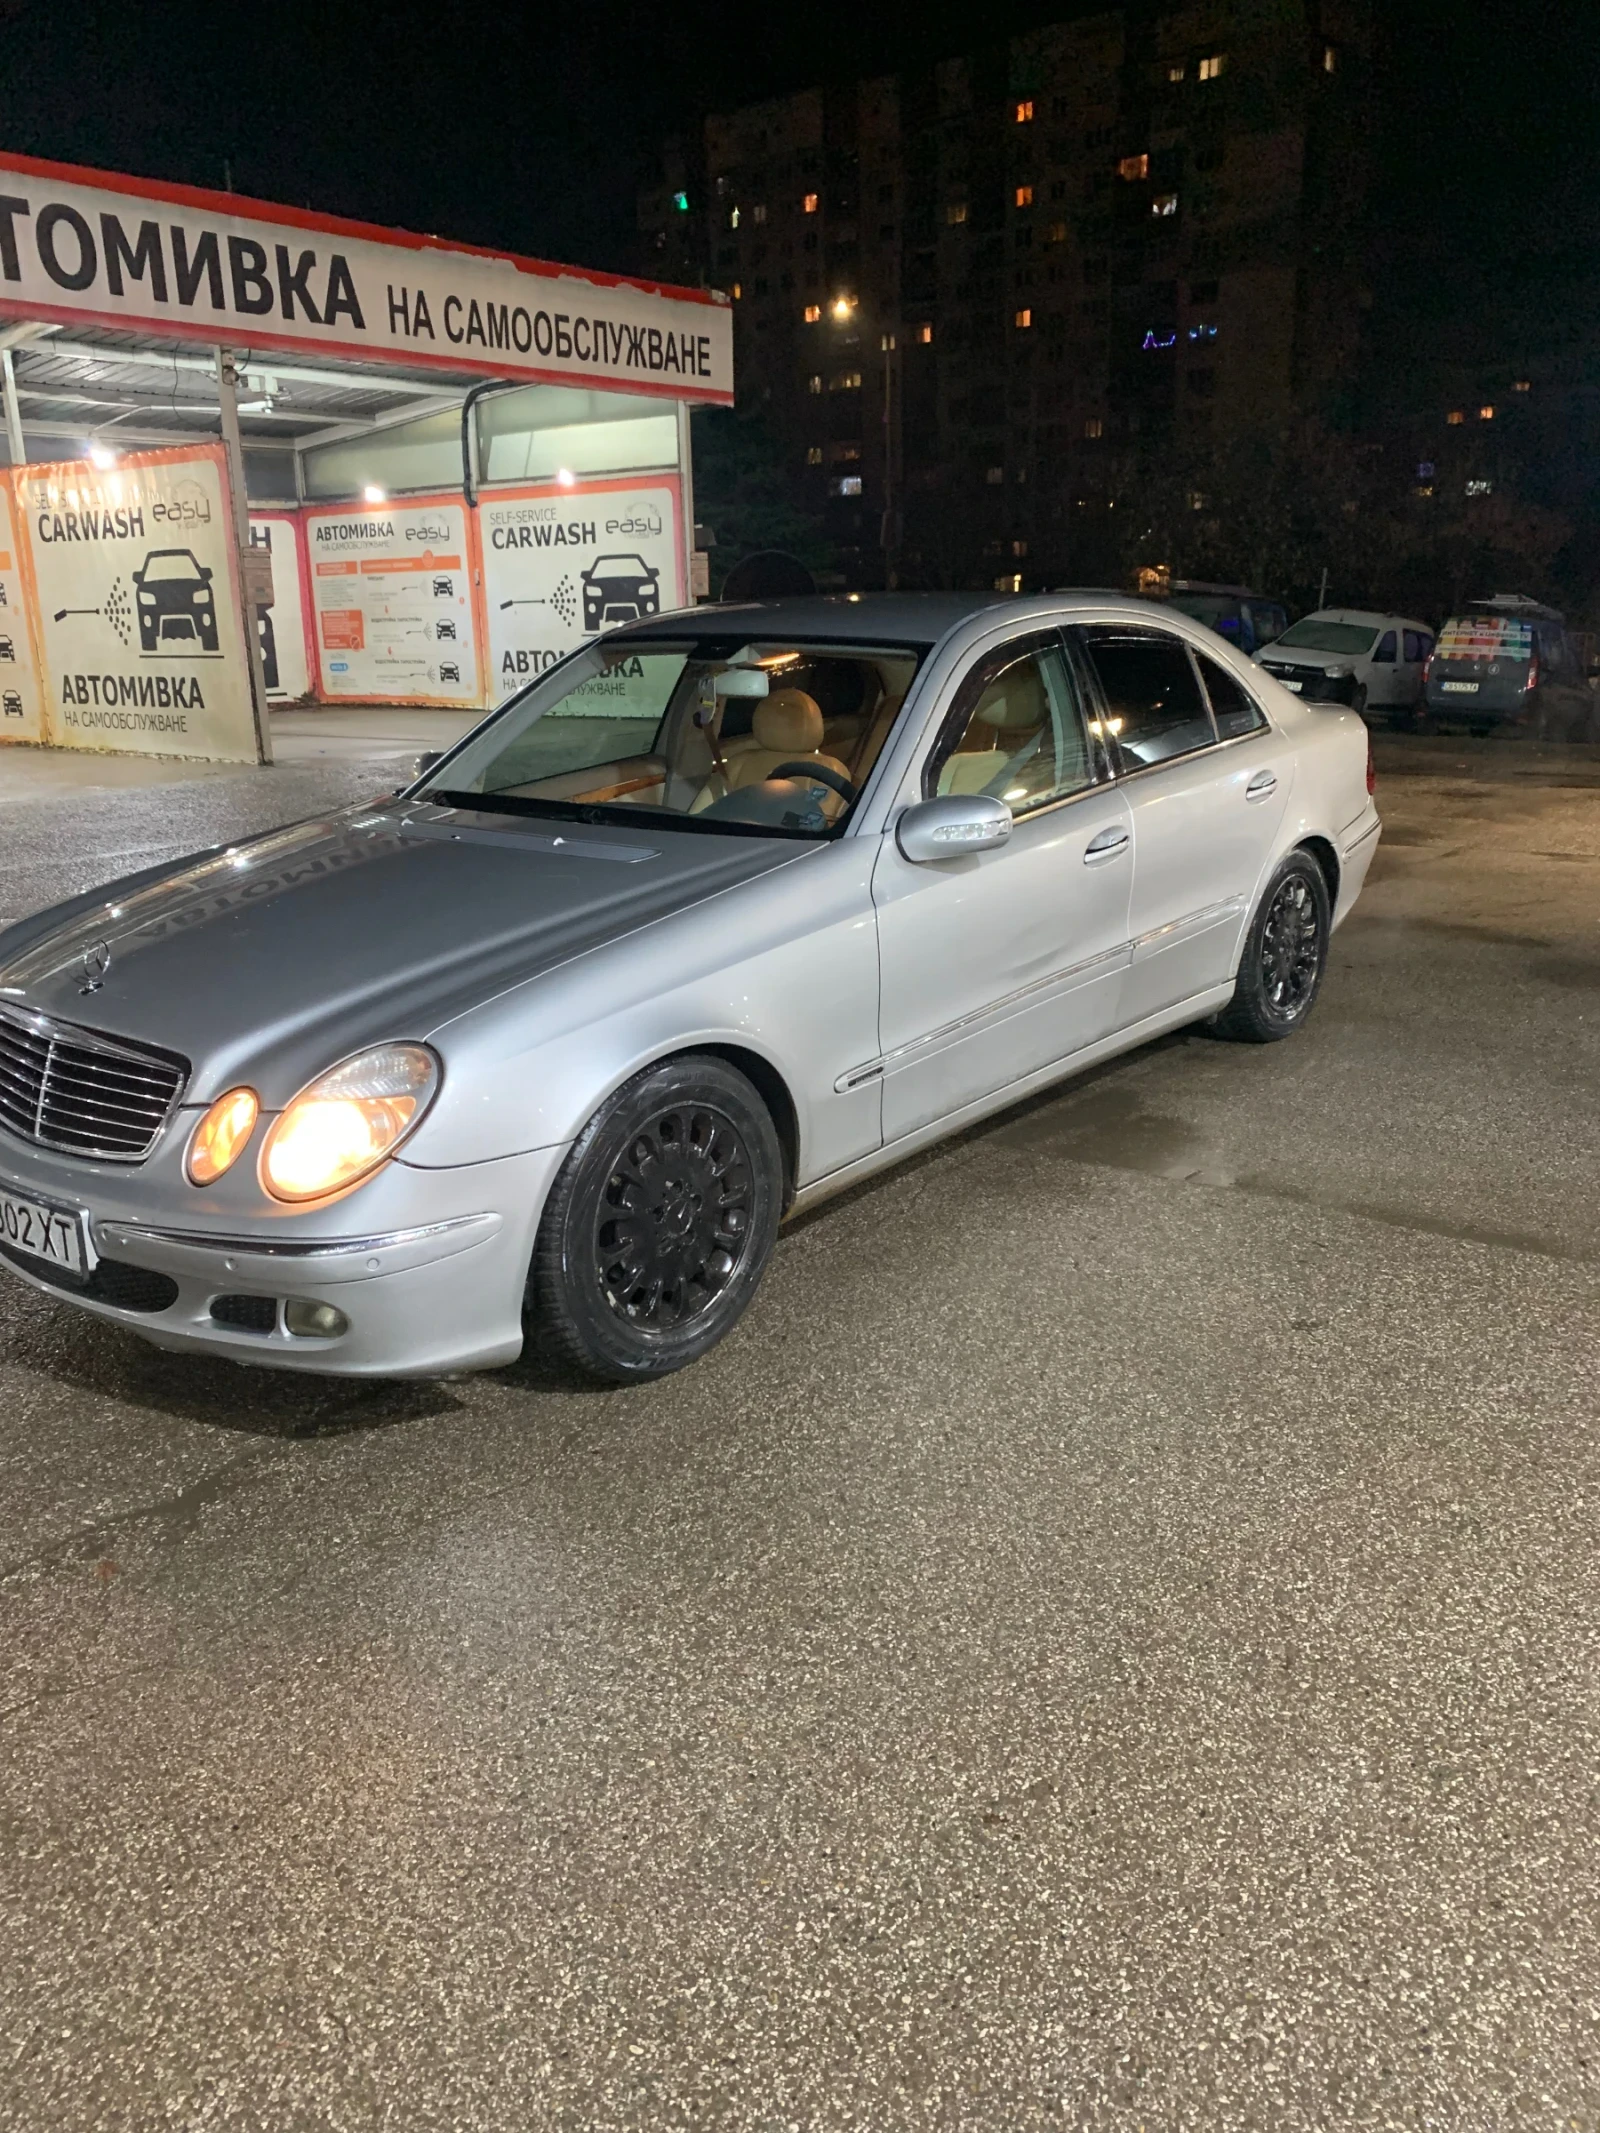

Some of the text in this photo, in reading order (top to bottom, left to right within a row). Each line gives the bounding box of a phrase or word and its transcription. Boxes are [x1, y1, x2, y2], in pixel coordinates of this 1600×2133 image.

[0, 194, 712, 377] ТОМИВКА НА САМООБСЛУЖВАНЕ
[152, 498, 211, 524] easy
[490, 507, 557, 526] SELF-SERVICE
[38, 506, 145, 543] CARWASH
[316, 522, 395, 541] АВТОМИВКА
[405, 525, 450, 541] easy
[491, 521, 597, 550] CARWASH
[605, 516, 663, 535] easy
[502, 650, 644, 678] АВТОКА
[63, 674, 205, 709] АВТОМИВКА
[64, 711, 188, 733] НА САМООБСЛУЖВАНЕ
